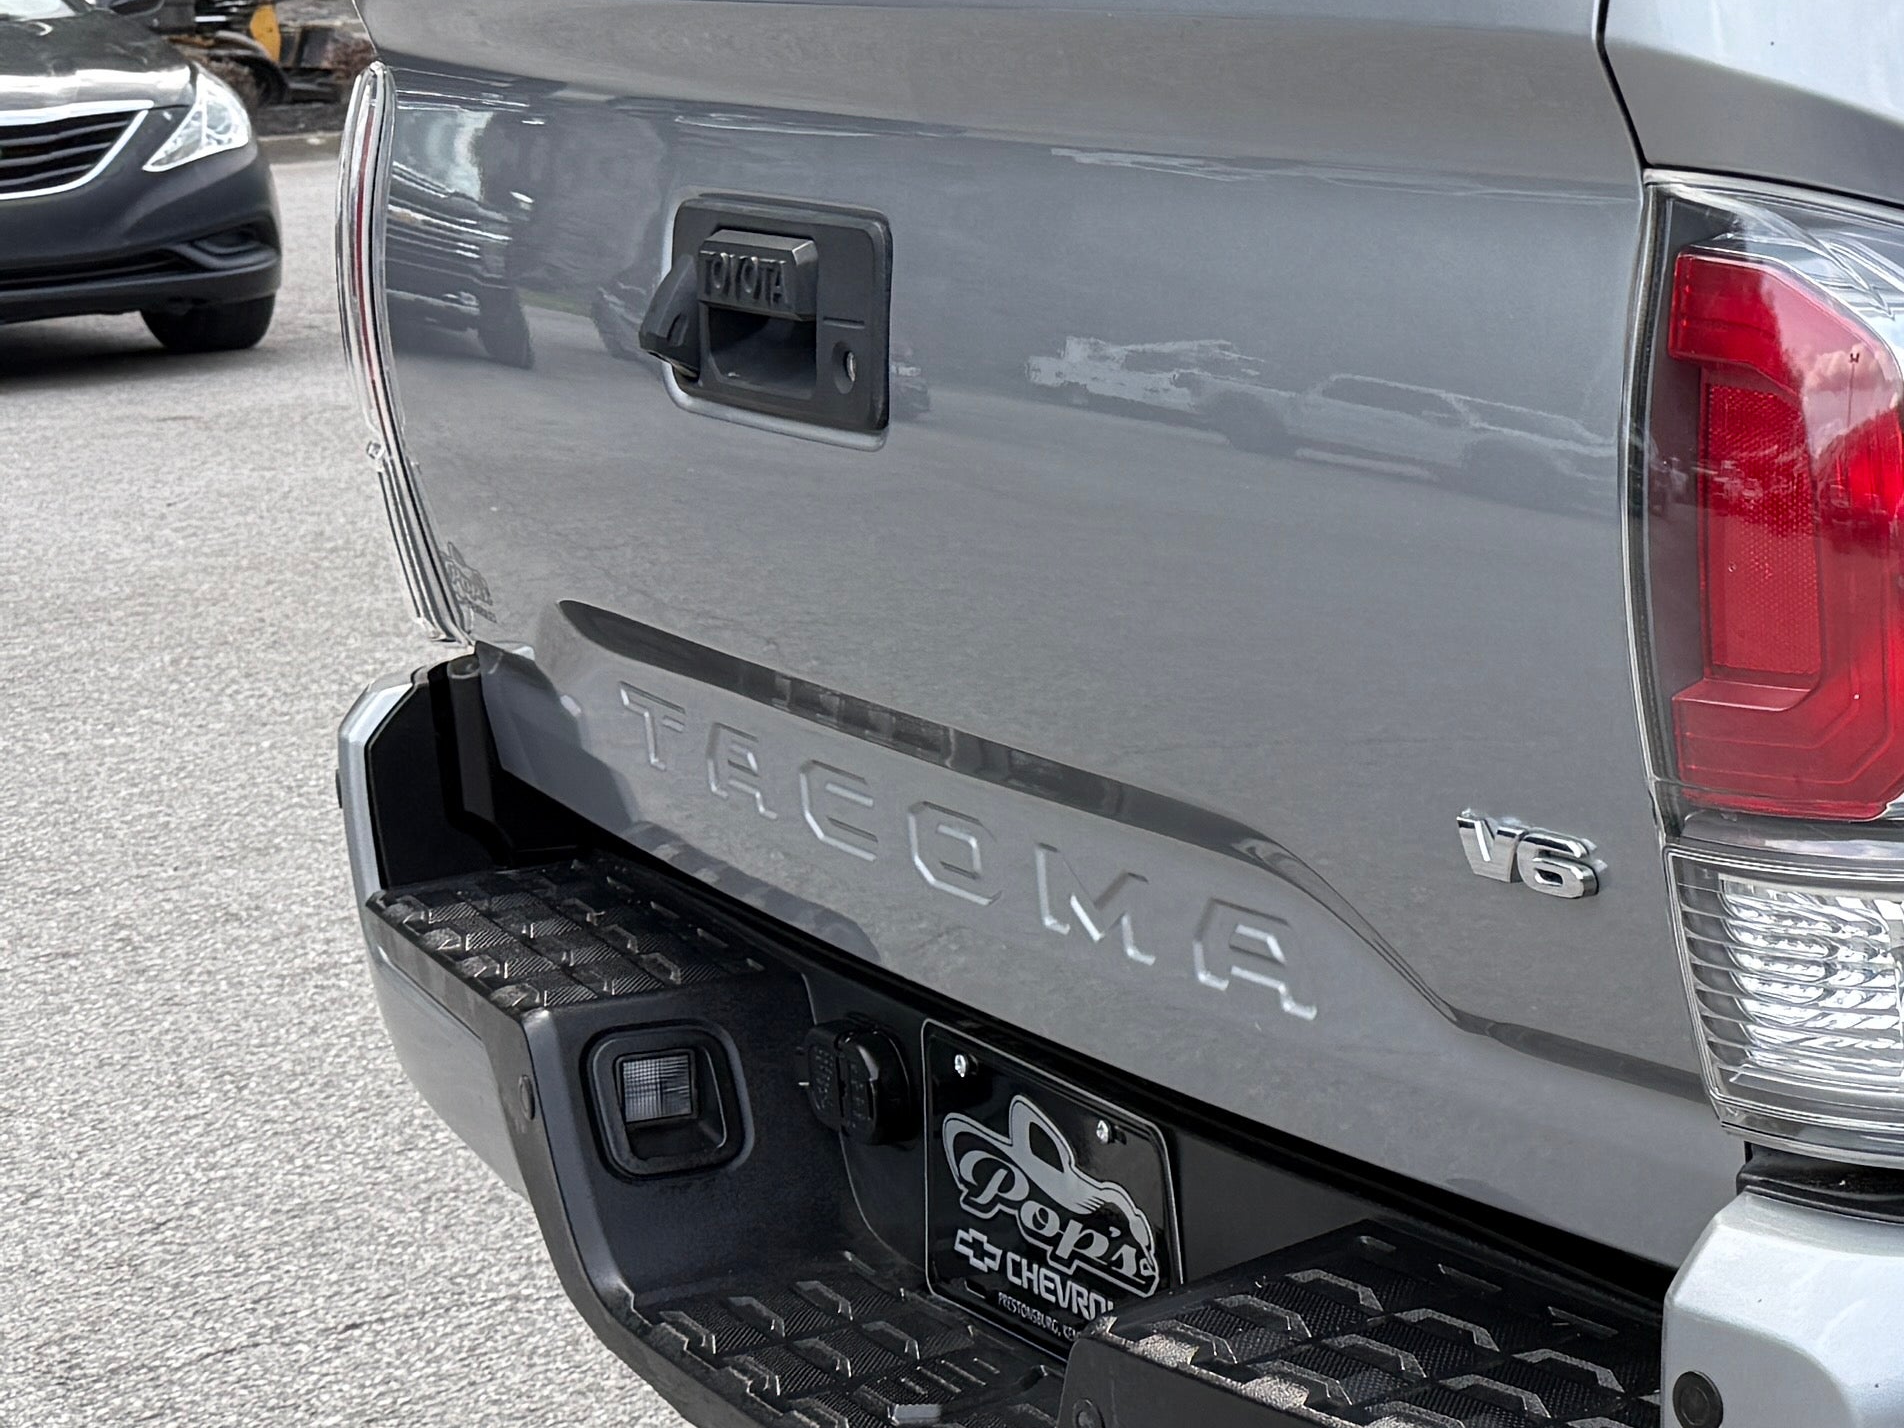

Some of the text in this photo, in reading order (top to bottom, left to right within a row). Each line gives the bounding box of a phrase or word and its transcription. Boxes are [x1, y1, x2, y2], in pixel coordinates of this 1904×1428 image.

[699, 249, 794, 307] TOYOTA
[616, 679, 1318, 1021] TACOMA
[1455, 808, 1600, 899] V6
[957, 1149, 1154, 1285] Pop's
[1005, 1250, 1114, 1321] CHEVRO
